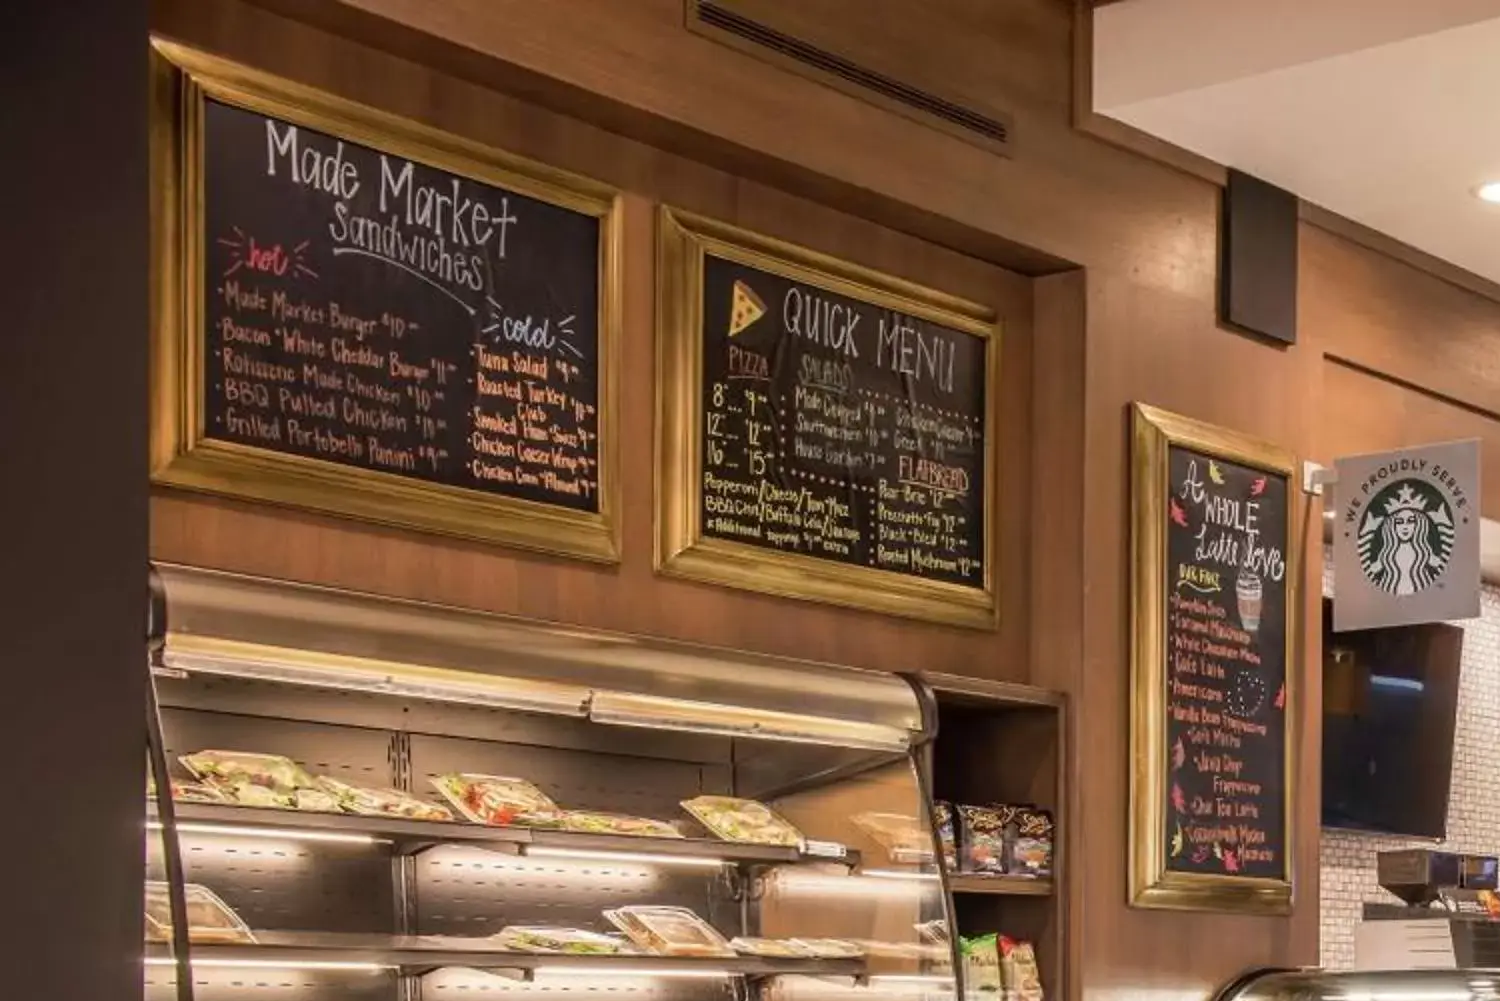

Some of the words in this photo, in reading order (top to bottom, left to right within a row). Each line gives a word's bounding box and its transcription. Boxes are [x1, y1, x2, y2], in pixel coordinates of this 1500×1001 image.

[264, 119, 360, 199] Made
[379, 154, 518, 258] Market
[246, 238, 289, 276] hot
[329, 201, 483, 290] Sandwiches
[225, 280, 268, 312] Made
[272, 291, 324, 323] Market
[329, 302, 378, 341] Burger
[503, 315, 556, 349] cold
[223, 316, 271, 346] Bacon
[282, 326, 326, 358] White
[331, 337, 384, 369] Cheddar
[473, 343, 509, 372] Tuna
[512, 351, 548, 380] Salad
[729, 345, 770, 376] PIZZA
[784, 287, 862, 358] QUICK
[877, 319, 955, 393] MENU
[224, 377, 270, 408] BBQ
[279, 387, 336, 419] Pulled
[343, 396, 407, 432] Chicken
[347, 372, 400, 407] Chicken
[477, 371, 523, 400] Roasted
[523, 379, 566, 411] Turkey
[226, 406, 281, 440] Grilled
[369, 436, 415, 471] Panini
[473, 432, 516, 458] Chicken
[473, 459, 516, 481] Chicken
[1180, 459, 1205, 503] A
[1346, 497, 1361, 522] WE
[1361, 458, 1427, 494] PROUDLY
[1431, 464, 1467, 508] SERVE
[1204, 491, 1261, 534] WHOLE
[1195, 523, 1240, 567] Latte
[1243, 532, 1285, 581] love
